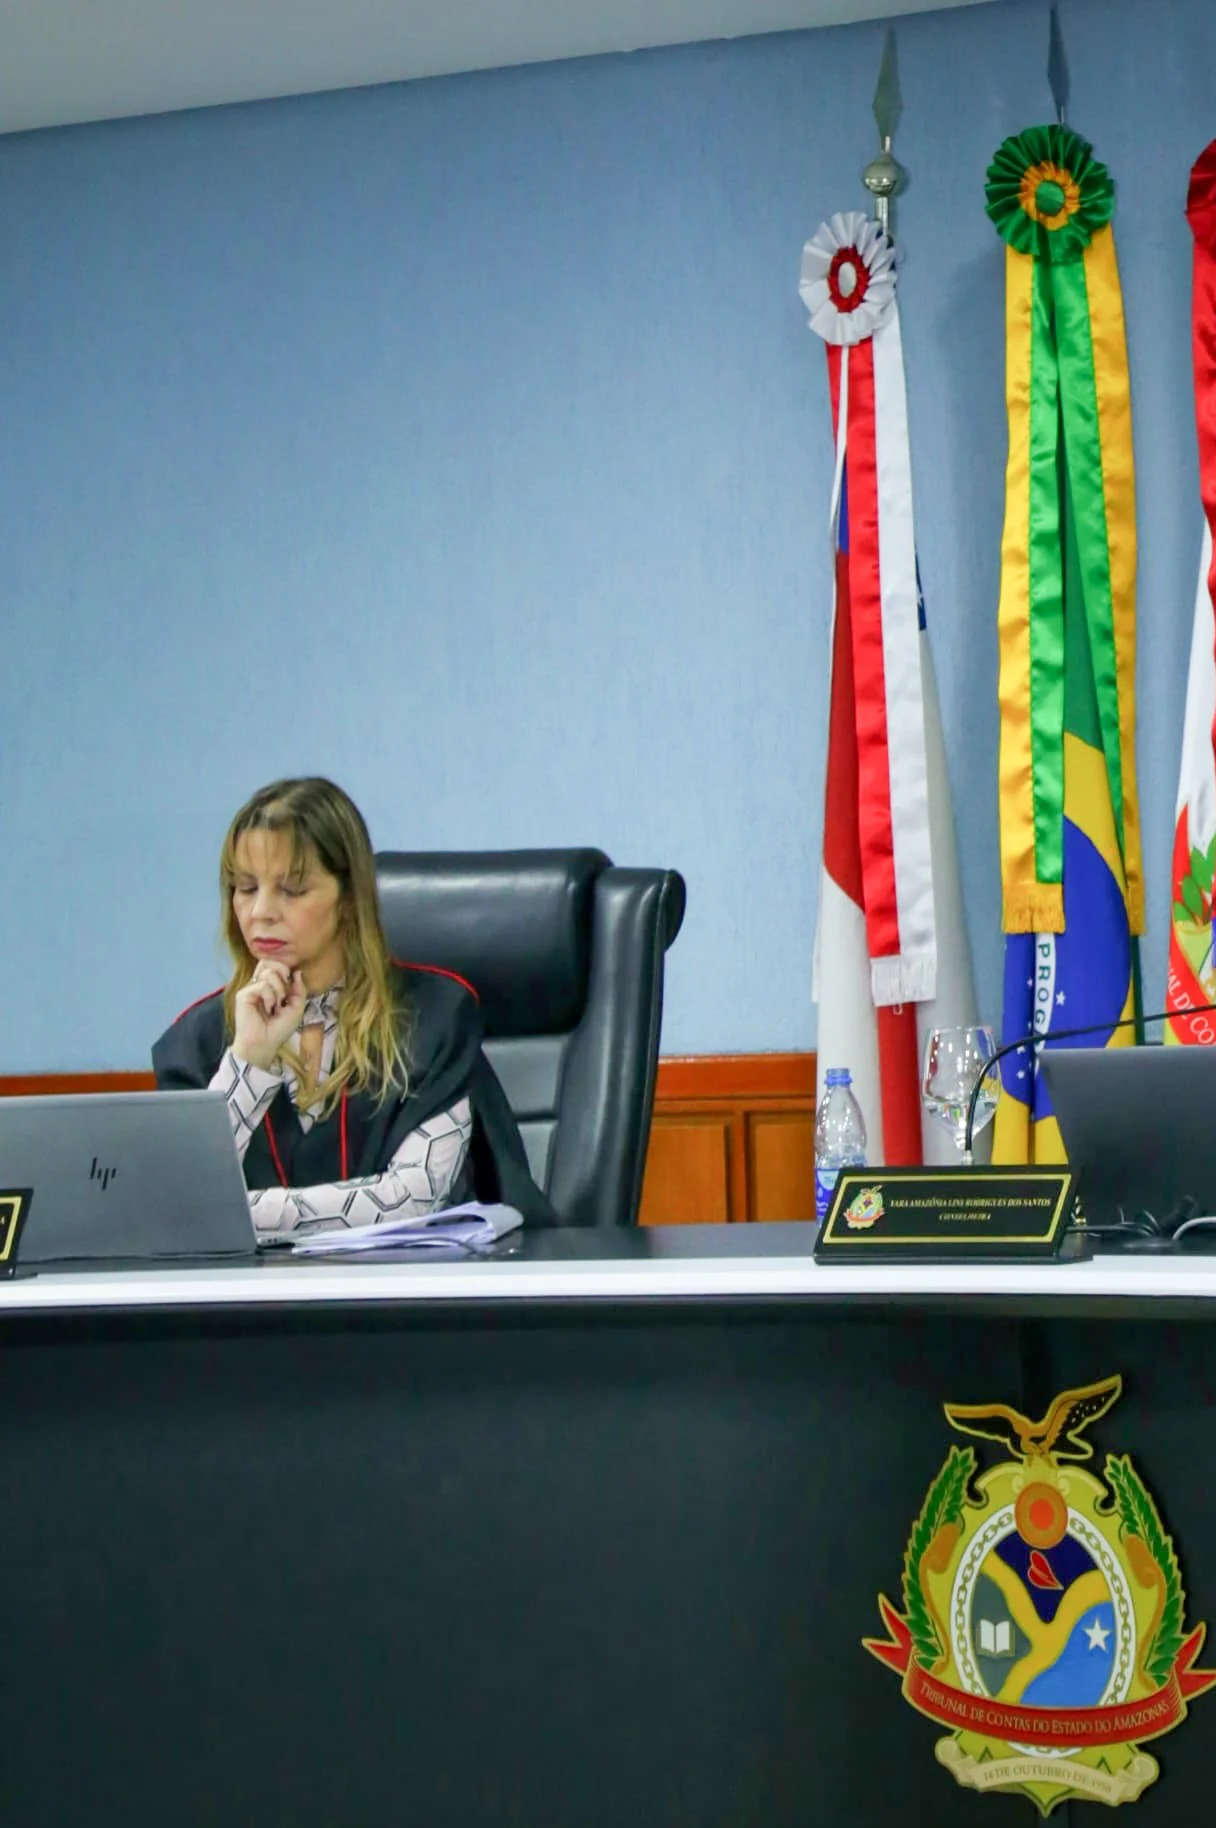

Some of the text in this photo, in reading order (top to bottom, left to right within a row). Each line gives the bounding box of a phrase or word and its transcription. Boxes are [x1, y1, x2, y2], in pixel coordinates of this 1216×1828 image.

[90, 1157, 117, 1191] hp
[920, 1681, 1170, 1734] TRIBUNAL DE CONTAS DO ESTADO DO AMAZONAS
[994, 1766, 1010, 1778] DE
[1013, 1764, 1070, 1780] OUTUBRO
